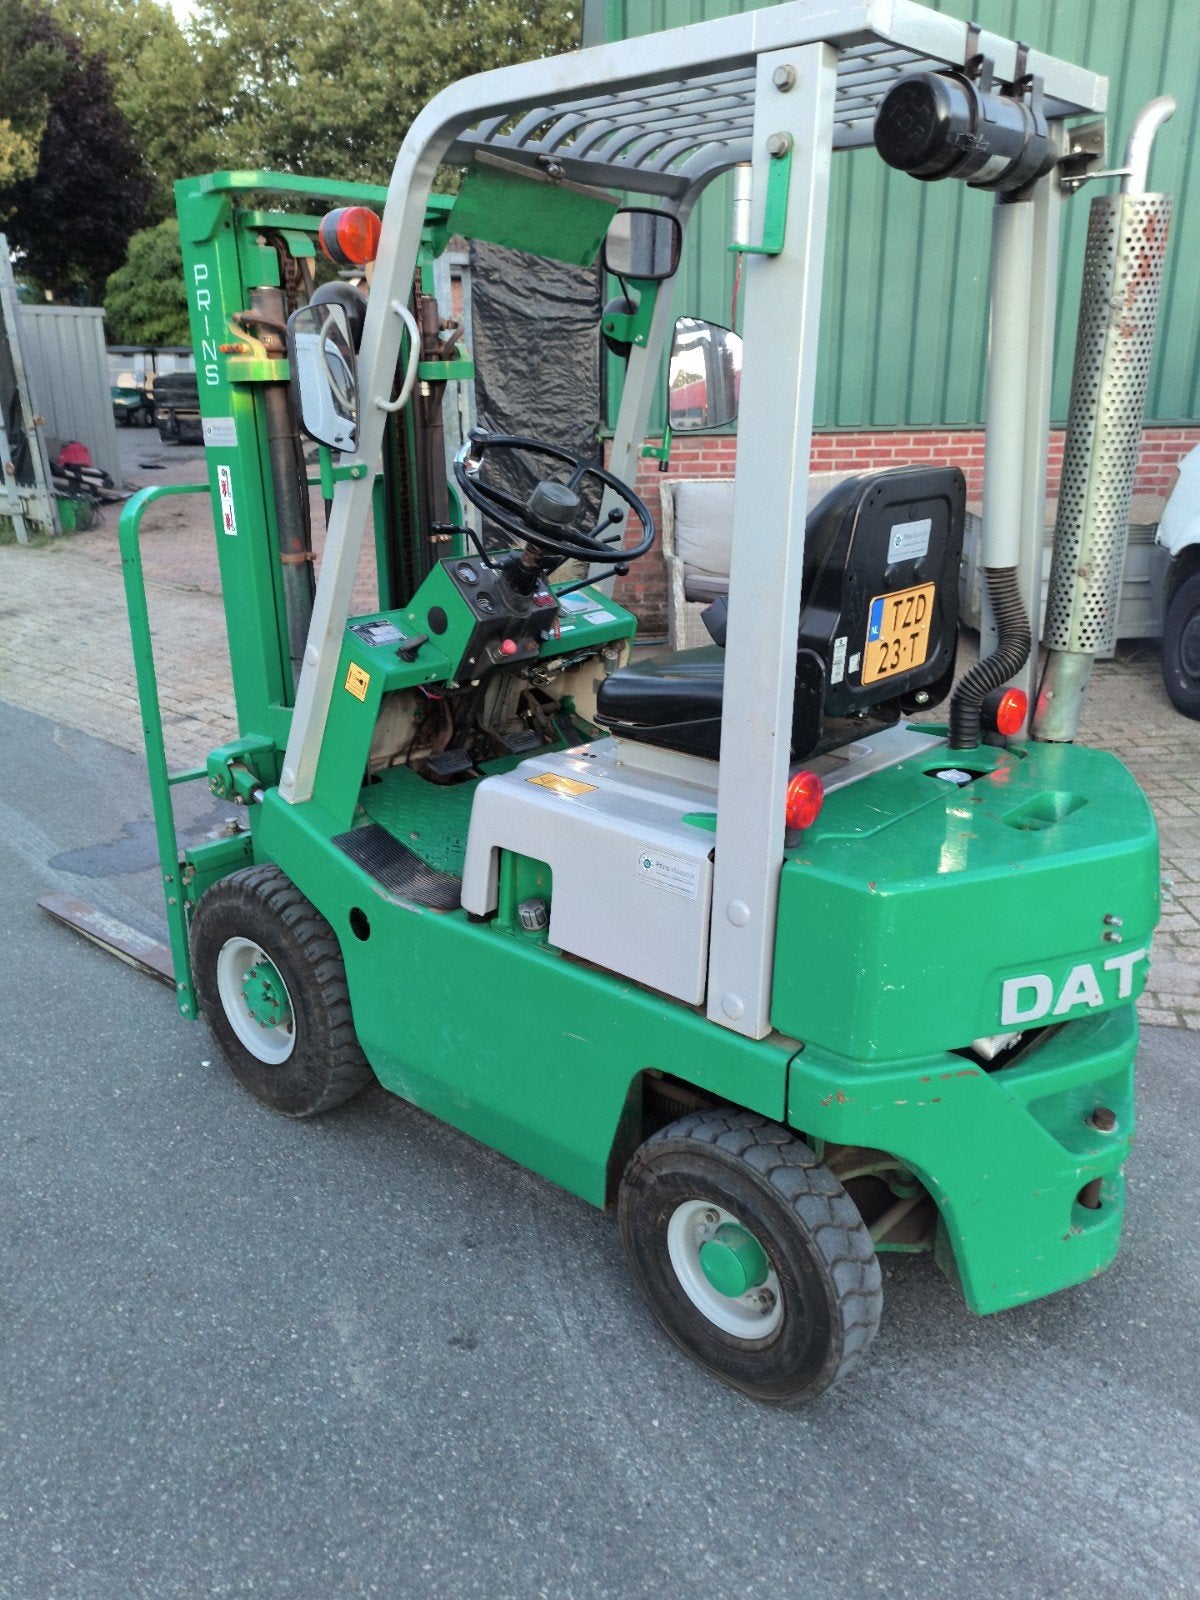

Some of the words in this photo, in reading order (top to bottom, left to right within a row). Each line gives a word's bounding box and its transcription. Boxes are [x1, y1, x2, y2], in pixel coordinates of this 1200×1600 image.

[194, 264, 220, 386] PRINS
[870, 625, 879, 635] NL
[893, 593, 927, 631] TZD
